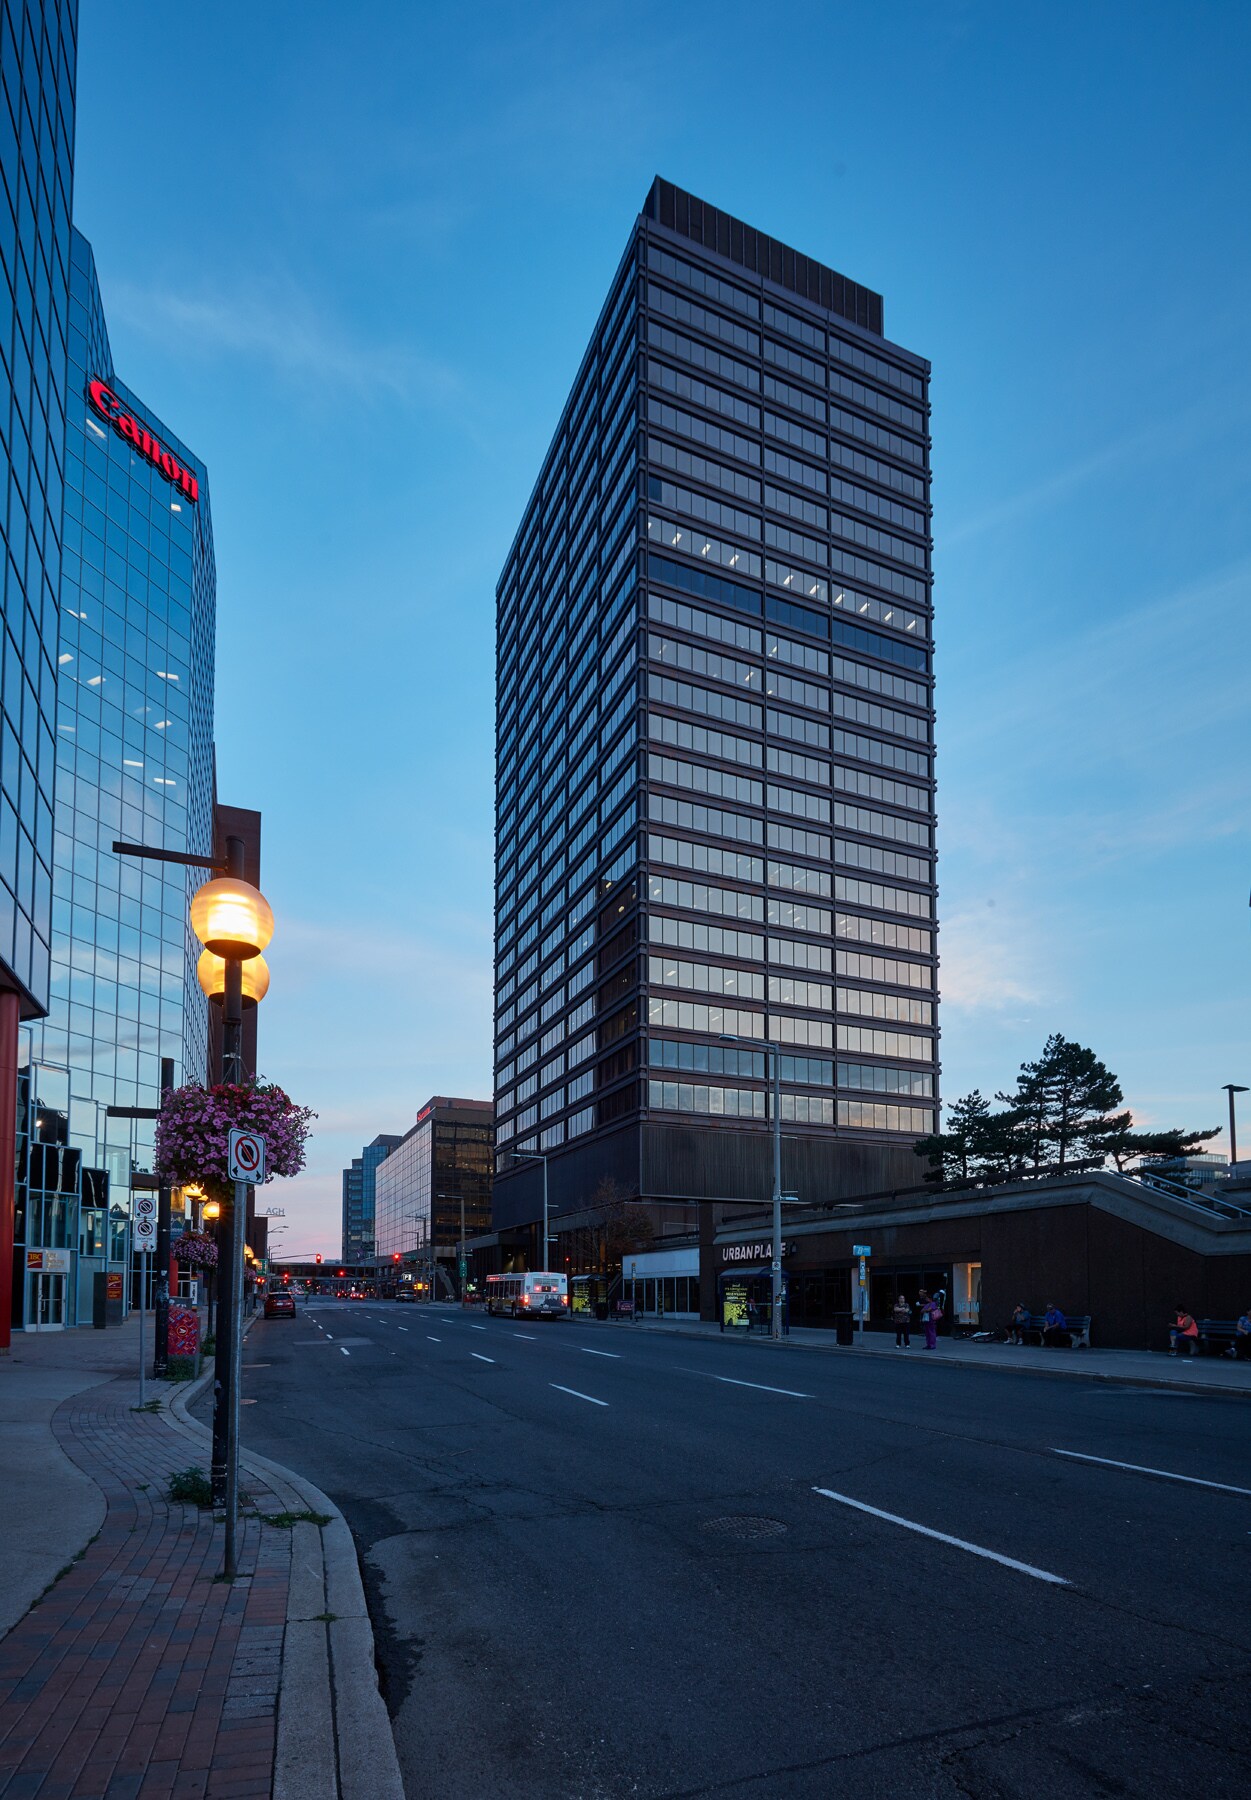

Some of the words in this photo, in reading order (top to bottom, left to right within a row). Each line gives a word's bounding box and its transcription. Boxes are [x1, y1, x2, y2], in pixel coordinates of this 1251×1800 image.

[89, 380, 198, 501] Canon
[266, 1207, 285, 1216] AGH
[722, 1246, 753, 1261] URBAN
